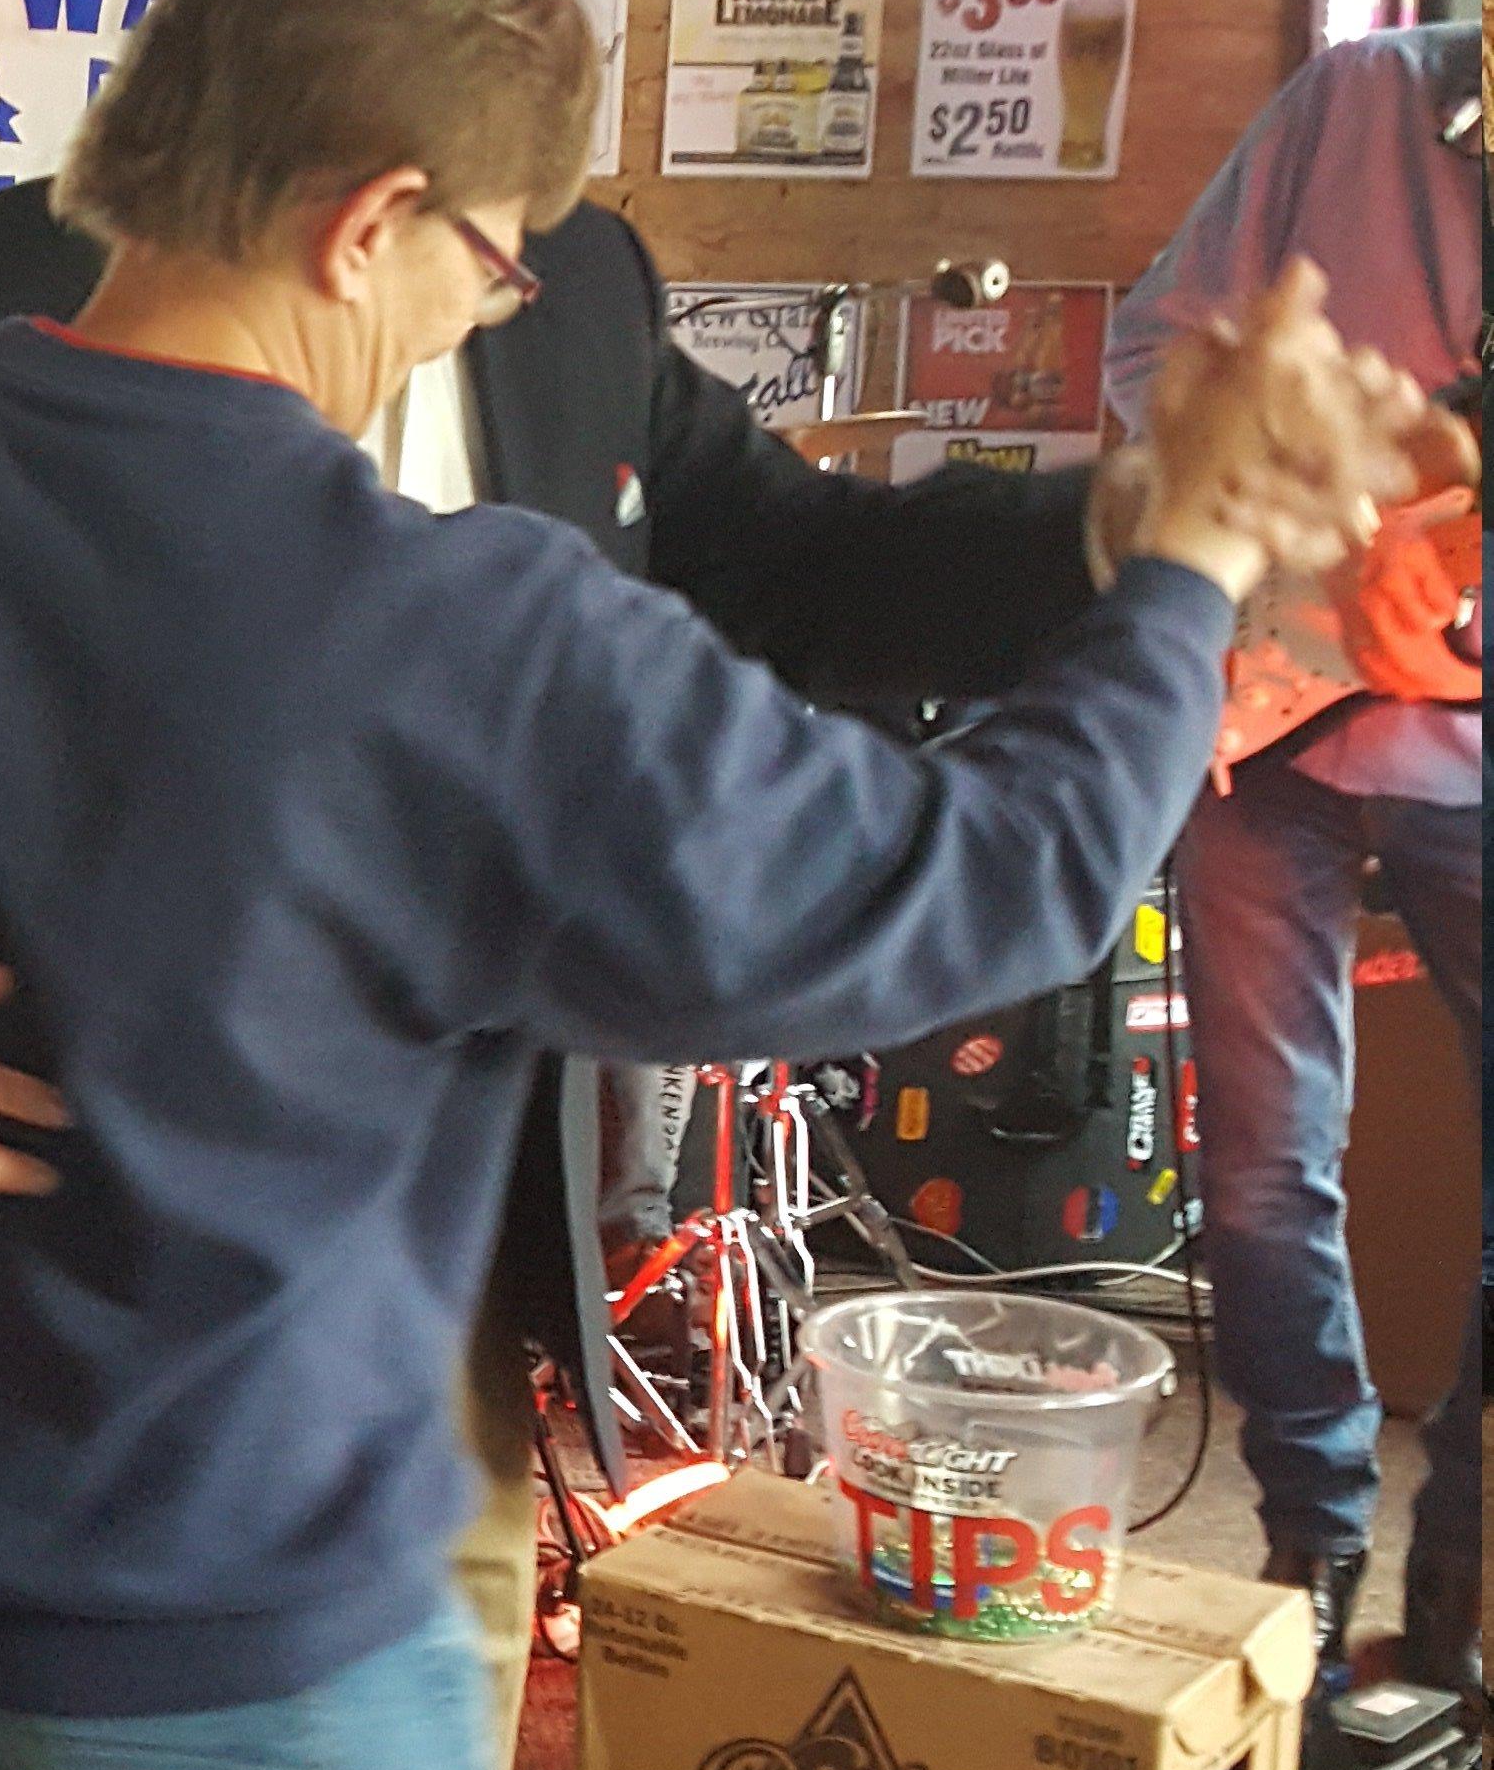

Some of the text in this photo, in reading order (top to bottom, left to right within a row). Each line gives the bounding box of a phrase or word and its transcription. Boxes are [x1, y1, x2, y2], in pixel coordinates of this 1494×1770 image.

[933, 328, 1009, 354] PICK
[909, 397, 991, 428] NEW
[907, 1441, 1019, 1476] LIGHT
[839, 1504, 1112, 1622] TIPS
